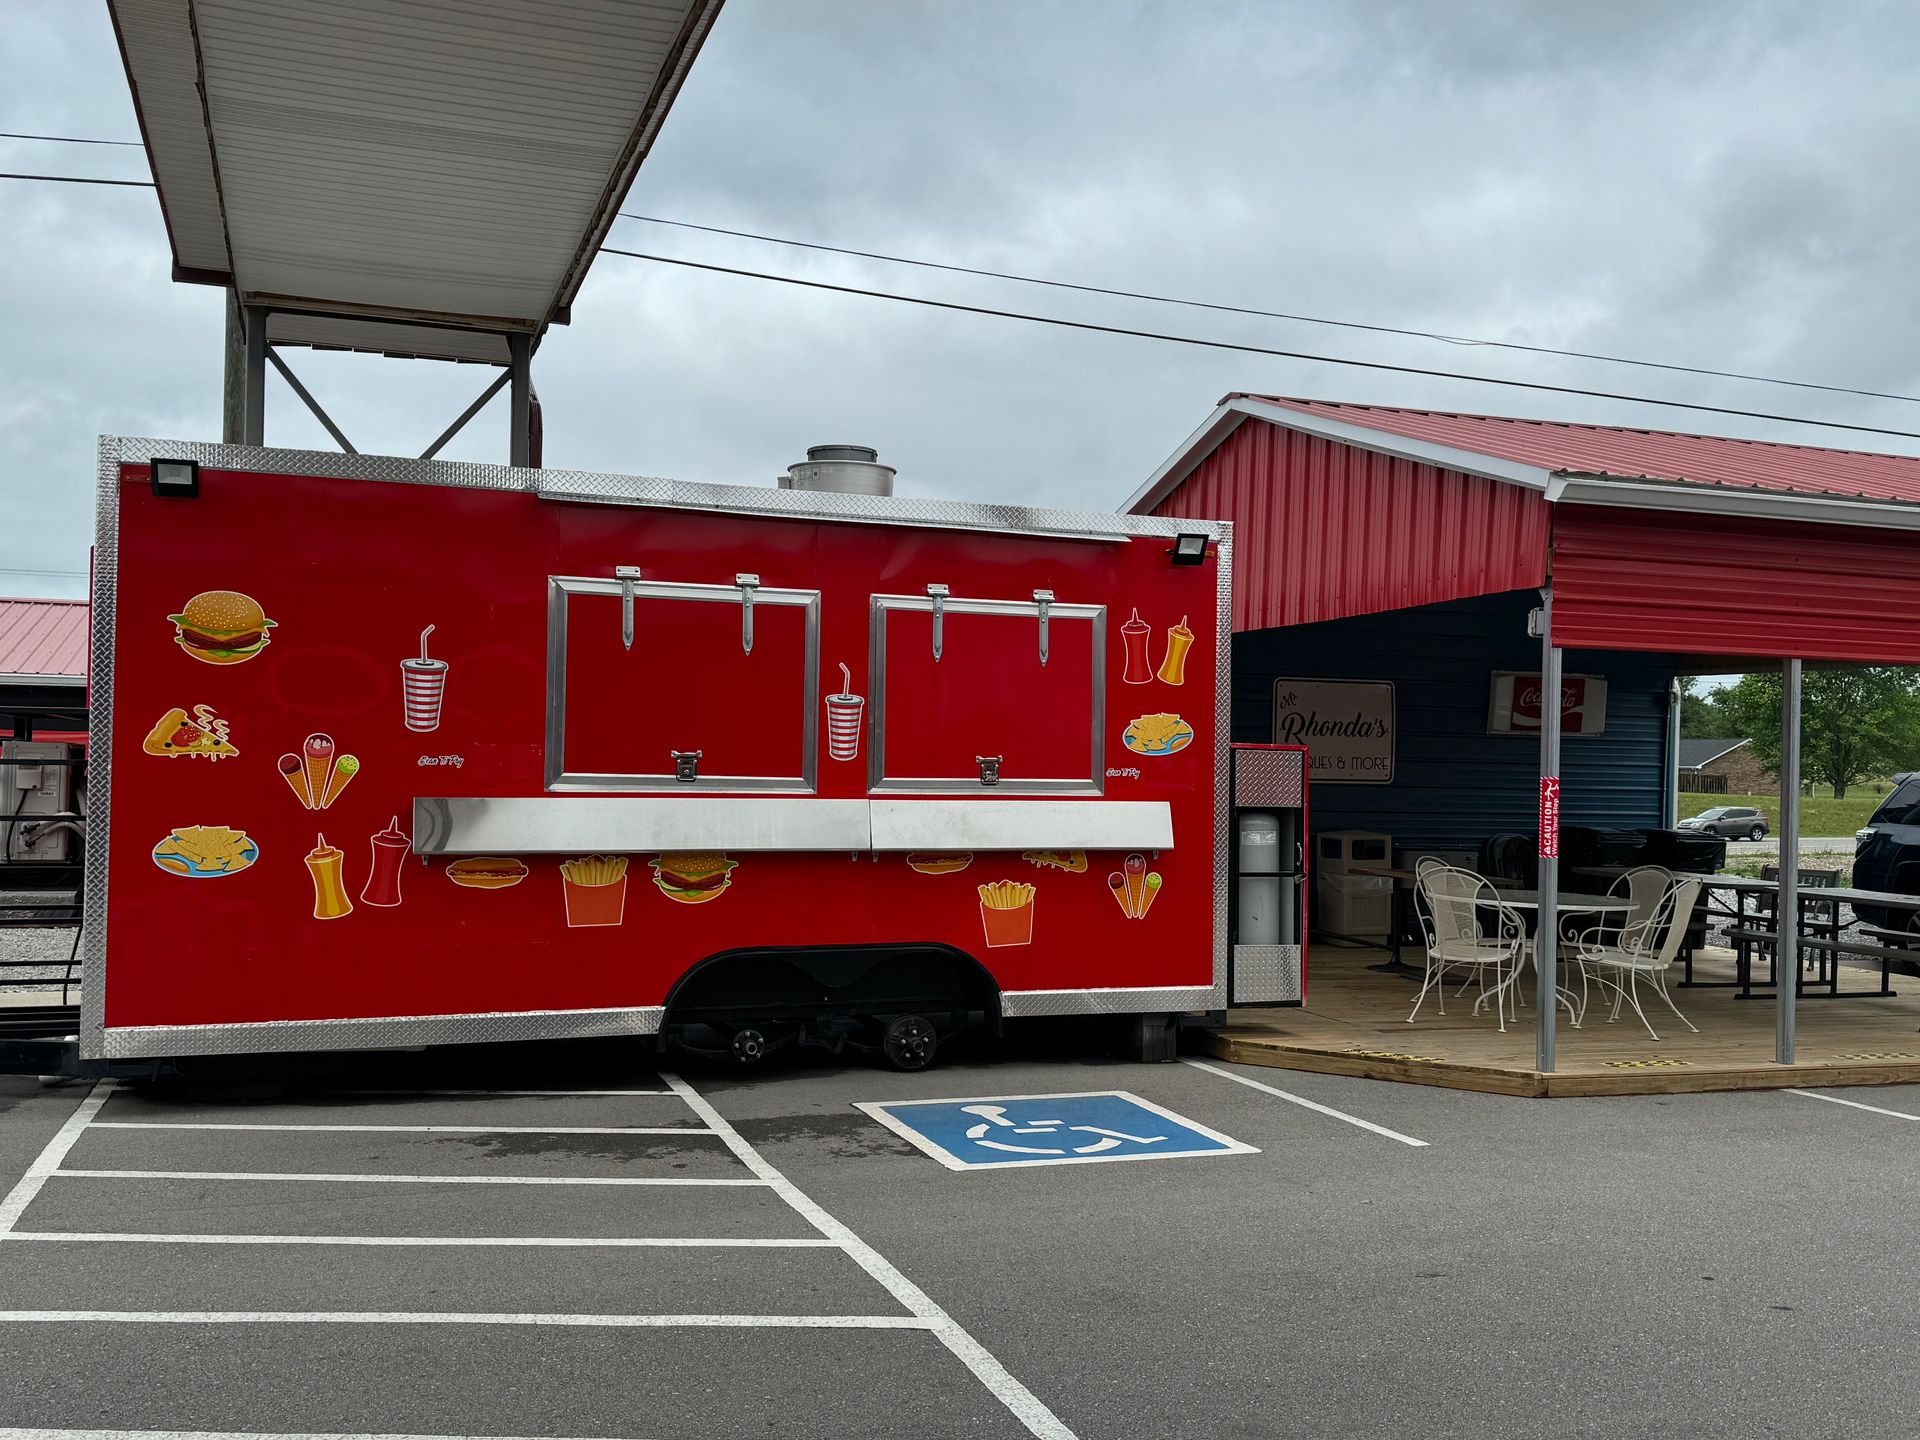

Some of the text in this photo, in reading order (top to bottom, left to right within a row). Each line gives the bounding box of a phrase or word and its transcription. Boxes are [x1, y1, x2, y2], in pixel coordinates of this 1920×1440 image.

[1281, 710, 1389, 746] Rhonda's
[1337, 756, 1346, 769] &
[1351, 756, 1389, 771] MORE
[1544, 801, 1552, 846] CAUTION
